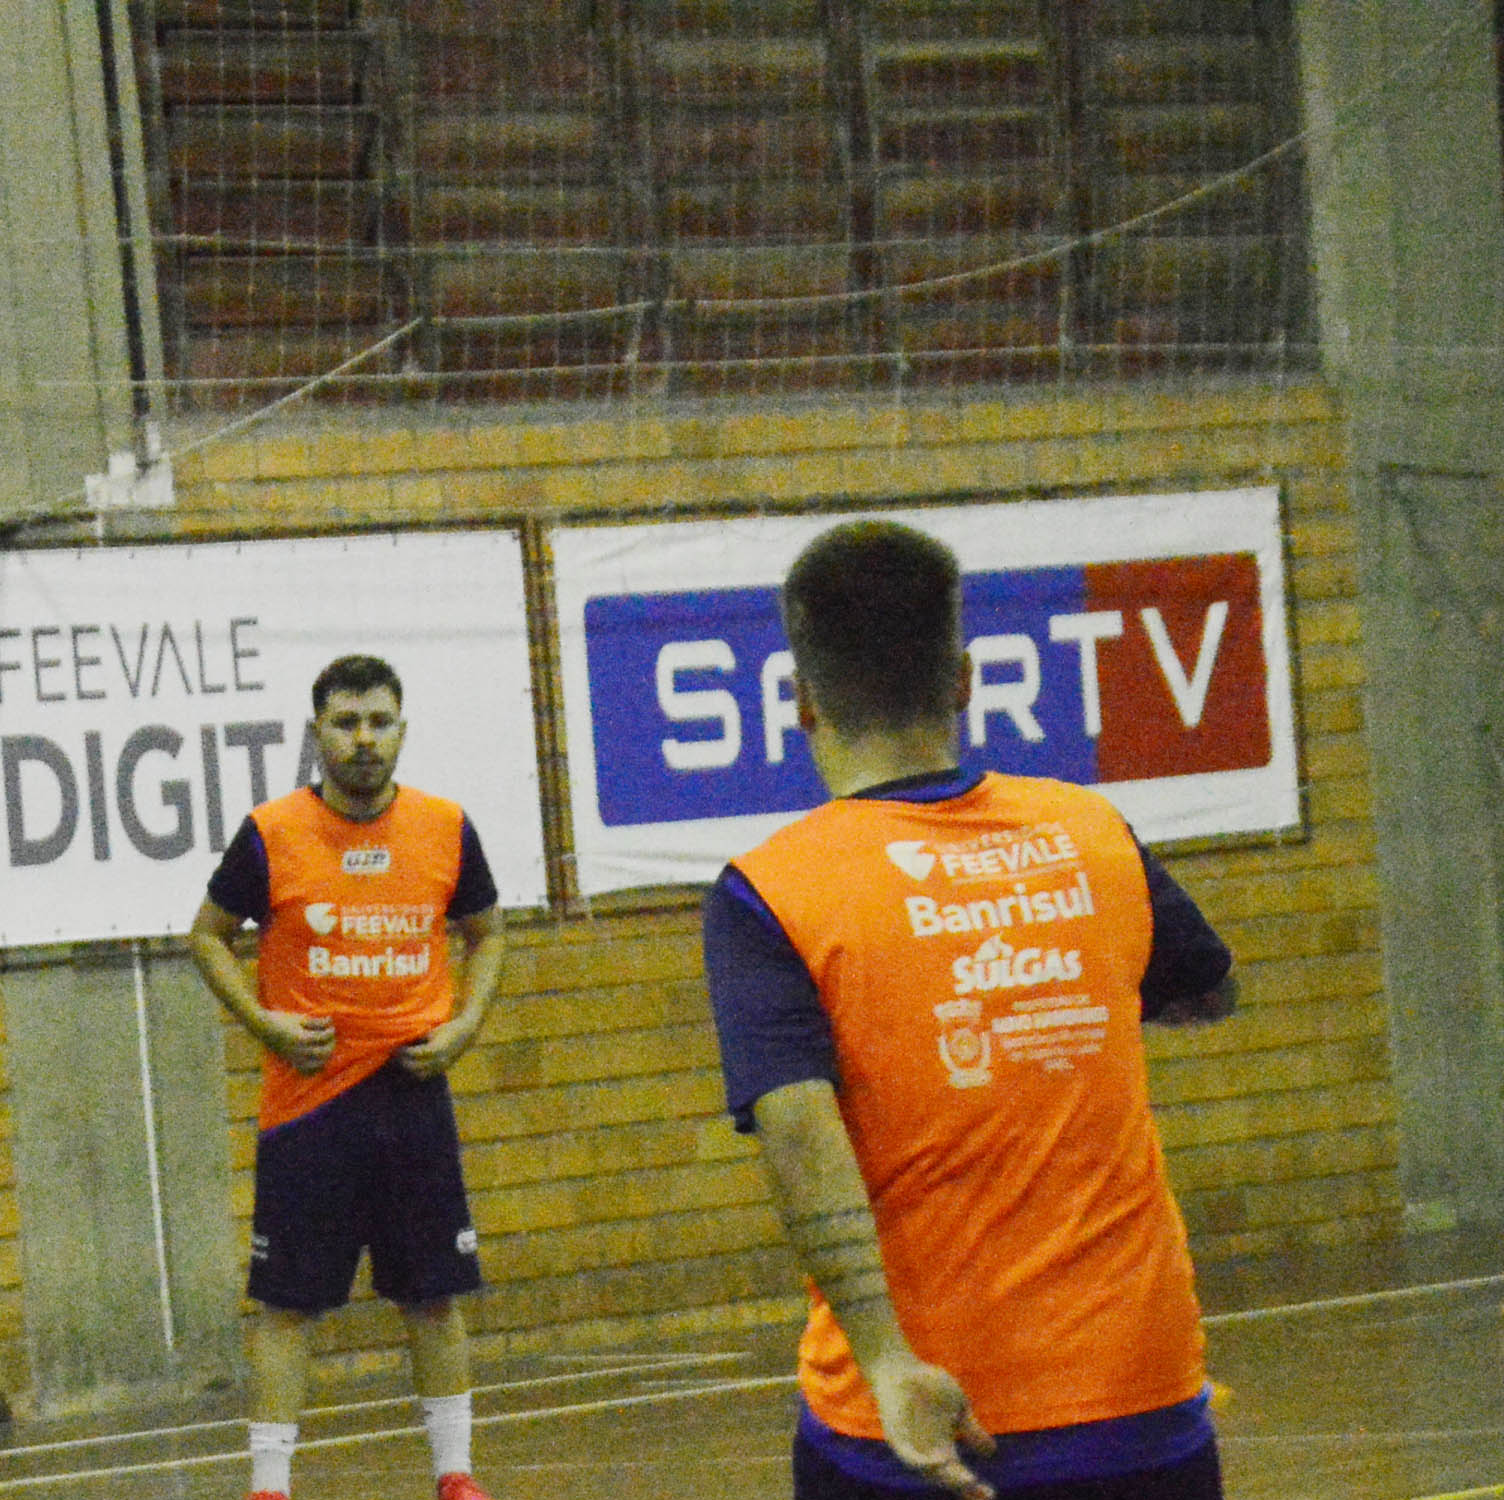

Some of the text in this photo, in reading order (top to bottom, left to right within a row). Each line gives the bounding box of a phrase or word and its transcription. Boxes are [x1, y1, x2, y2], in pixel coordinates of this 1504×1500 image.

[654, 600, 1229, 771] SPRTV
[941, 834, 1078, 877] FEEVALE
[341, 914, 435, 936] FEEVALE
[905, 871, 1096, 937] Banrisul
[308, 943, 431, 978] Banrisul
